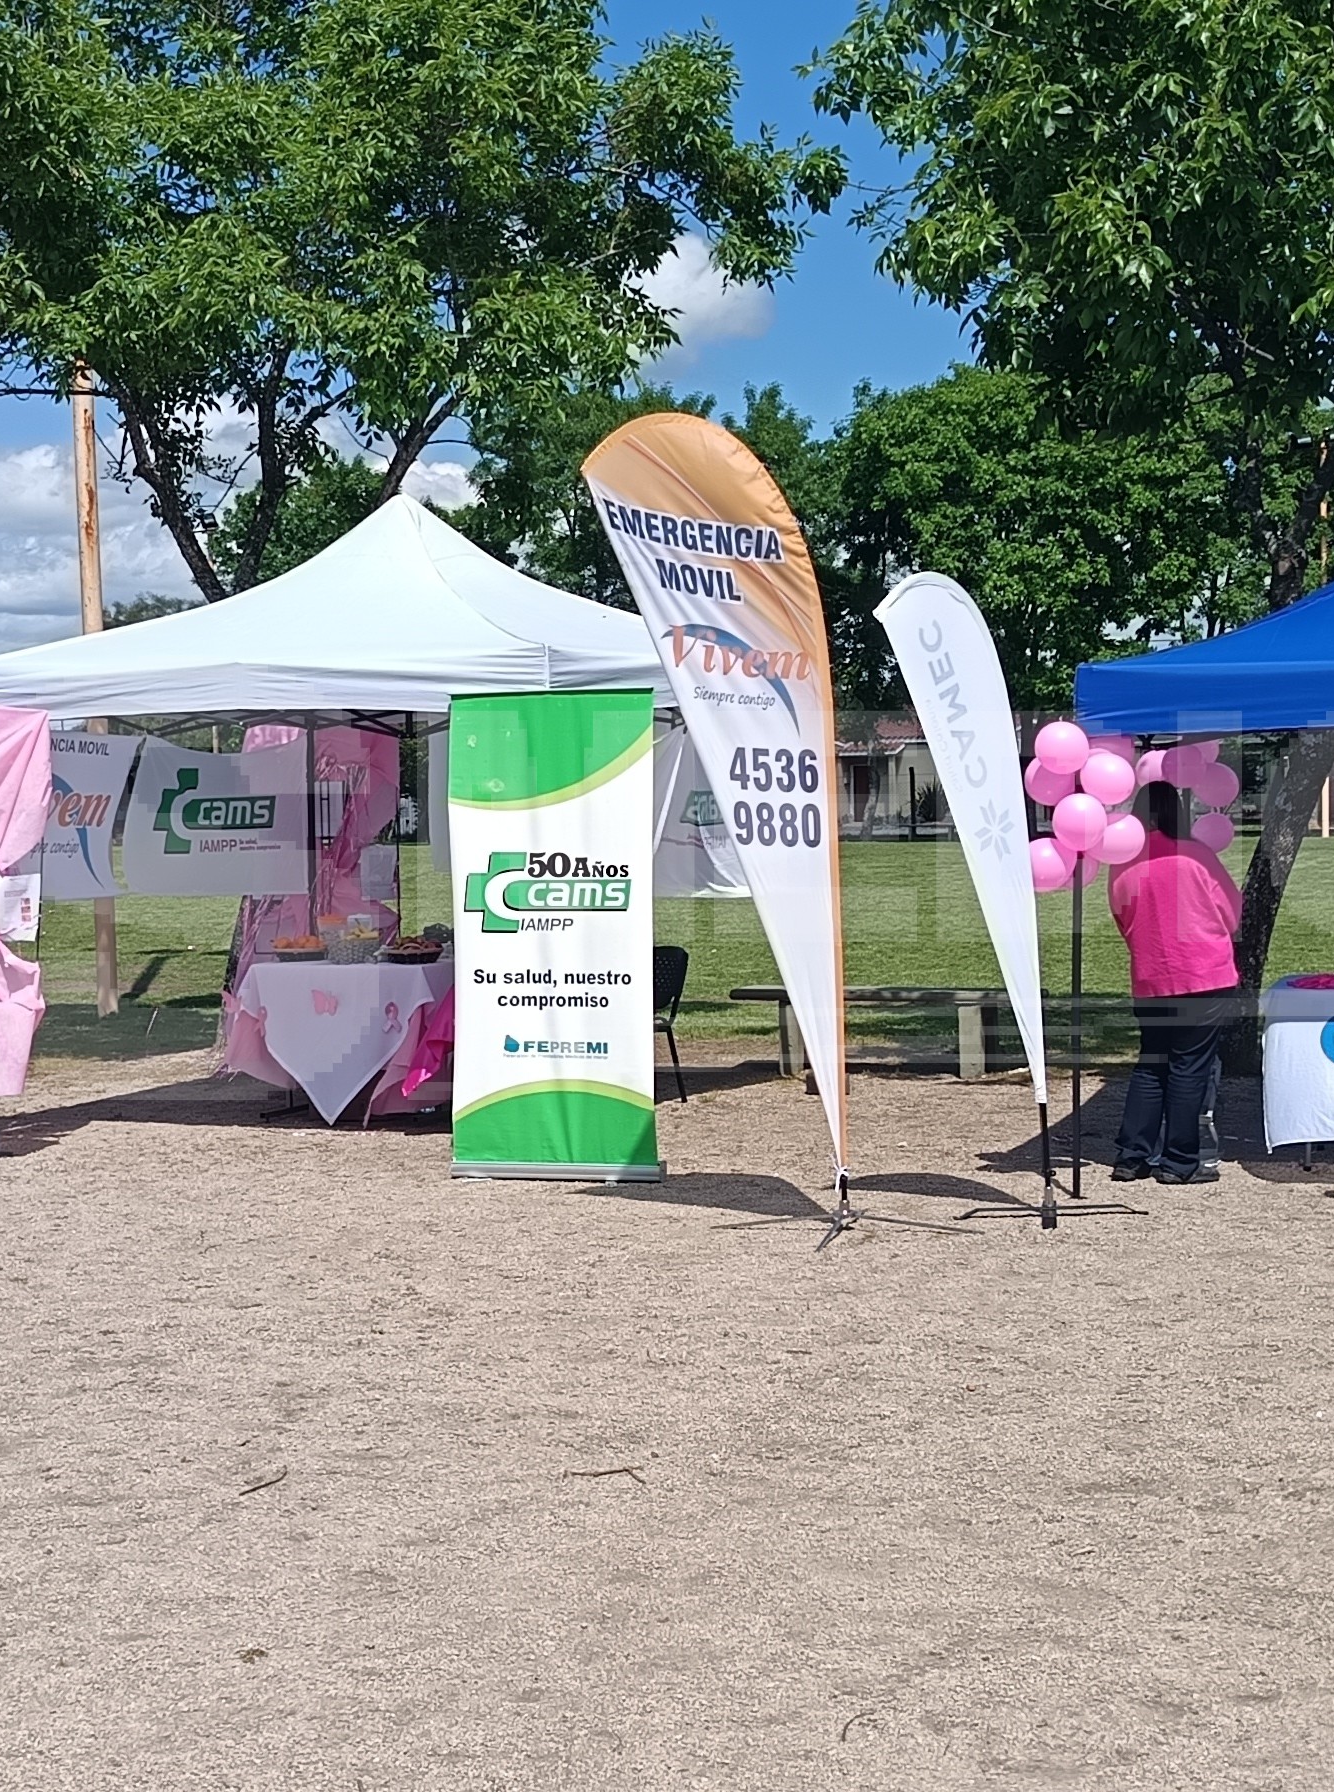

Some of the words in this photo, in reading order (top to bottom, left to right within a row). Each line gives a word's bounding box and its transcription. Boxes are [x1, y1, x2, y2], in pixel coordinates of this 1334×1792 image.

[603, 498, 783, 560] EMERGENCIA
[655, 558, 742, 601] MOVIL
[668, 624, 811, 681] Vivem
[694, 686, 735, 704] Siempre
[738, 692, 776, 710] contigo
[78, 740, 110, 756] MOVIL
[730, 747, 819, 793] 4536
[48, 792, 112, 829] vem
[197, 799, 270, 826] cams
[733, 800, 822, 849] 9880
[199, 838, 238, 853] IAMPP
[527, 852, 572, 878] 50
[527, 882, 627, 907] cams
[520, 918, 574, 932] IAMPP
[473, 969, 497, 984] Su
[503, 969, 557, 988] salud,
[564, 970, 632, 985] nuestro
[497, 992, 609, 1010] compromiso
[523, 1040, 609, 1054] FEPREMI
